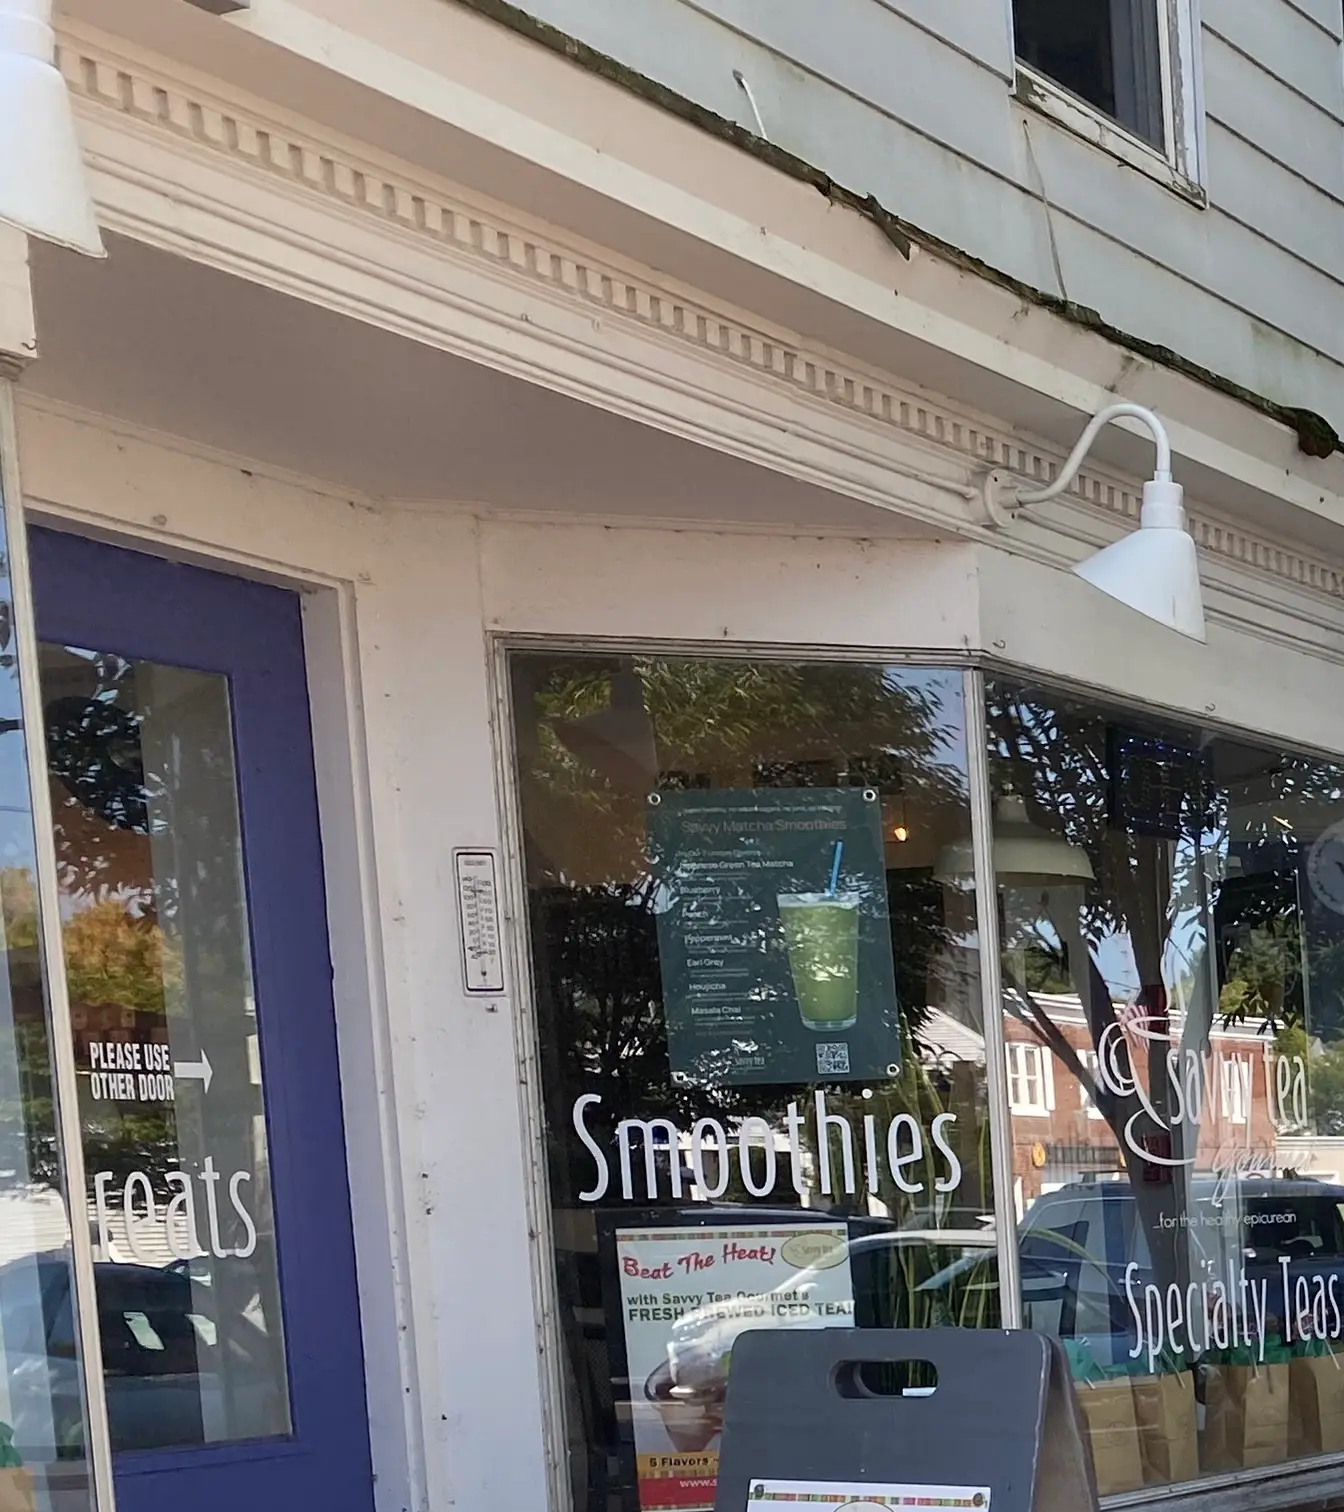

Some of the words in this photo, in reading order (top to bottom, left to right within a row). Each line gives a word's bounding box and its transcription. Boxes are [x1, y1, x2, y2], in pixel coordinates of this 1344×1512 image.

[723, 820, 772, 832] Matcha
[775, 819, 847, 831] Smoothies
[687, 959, 702, 967] Earl
[89, 1042, 142, 1071] PLEASE
[143, 1044, 170, 1071] USE
[90, 1074, 136, 1100] OTHER
[138, 1073, 175, 1101] DOOR
[1262, 1042, 1308, 1129] tea
[572, 1088, 962, 1201] Smoothies
[1180, 1211, 1197, 1225] the
[1244, 1213, 1296, 1228] epicurean
[622, 1256, 674, 1280] Beat
[677, 1252, 715, 1274] The
[721, 1243, 777, 1266] Heat!
[627, 1293, 658, 1305] with
[662, 1292, 703, 1306] Savvy
[706, 1291, 732, 1302] Tea
[628, 1307, 685, 1321] FRESH
[770, 1302, 810, 1317] ICED
[815, 1302, 853, 1317] TEA!
[1125, 1258, 1267, 1373] Specialty
[1278, 1256, 1341, 1342] Teas
[661, 1457, 709, 1467] Flavors
